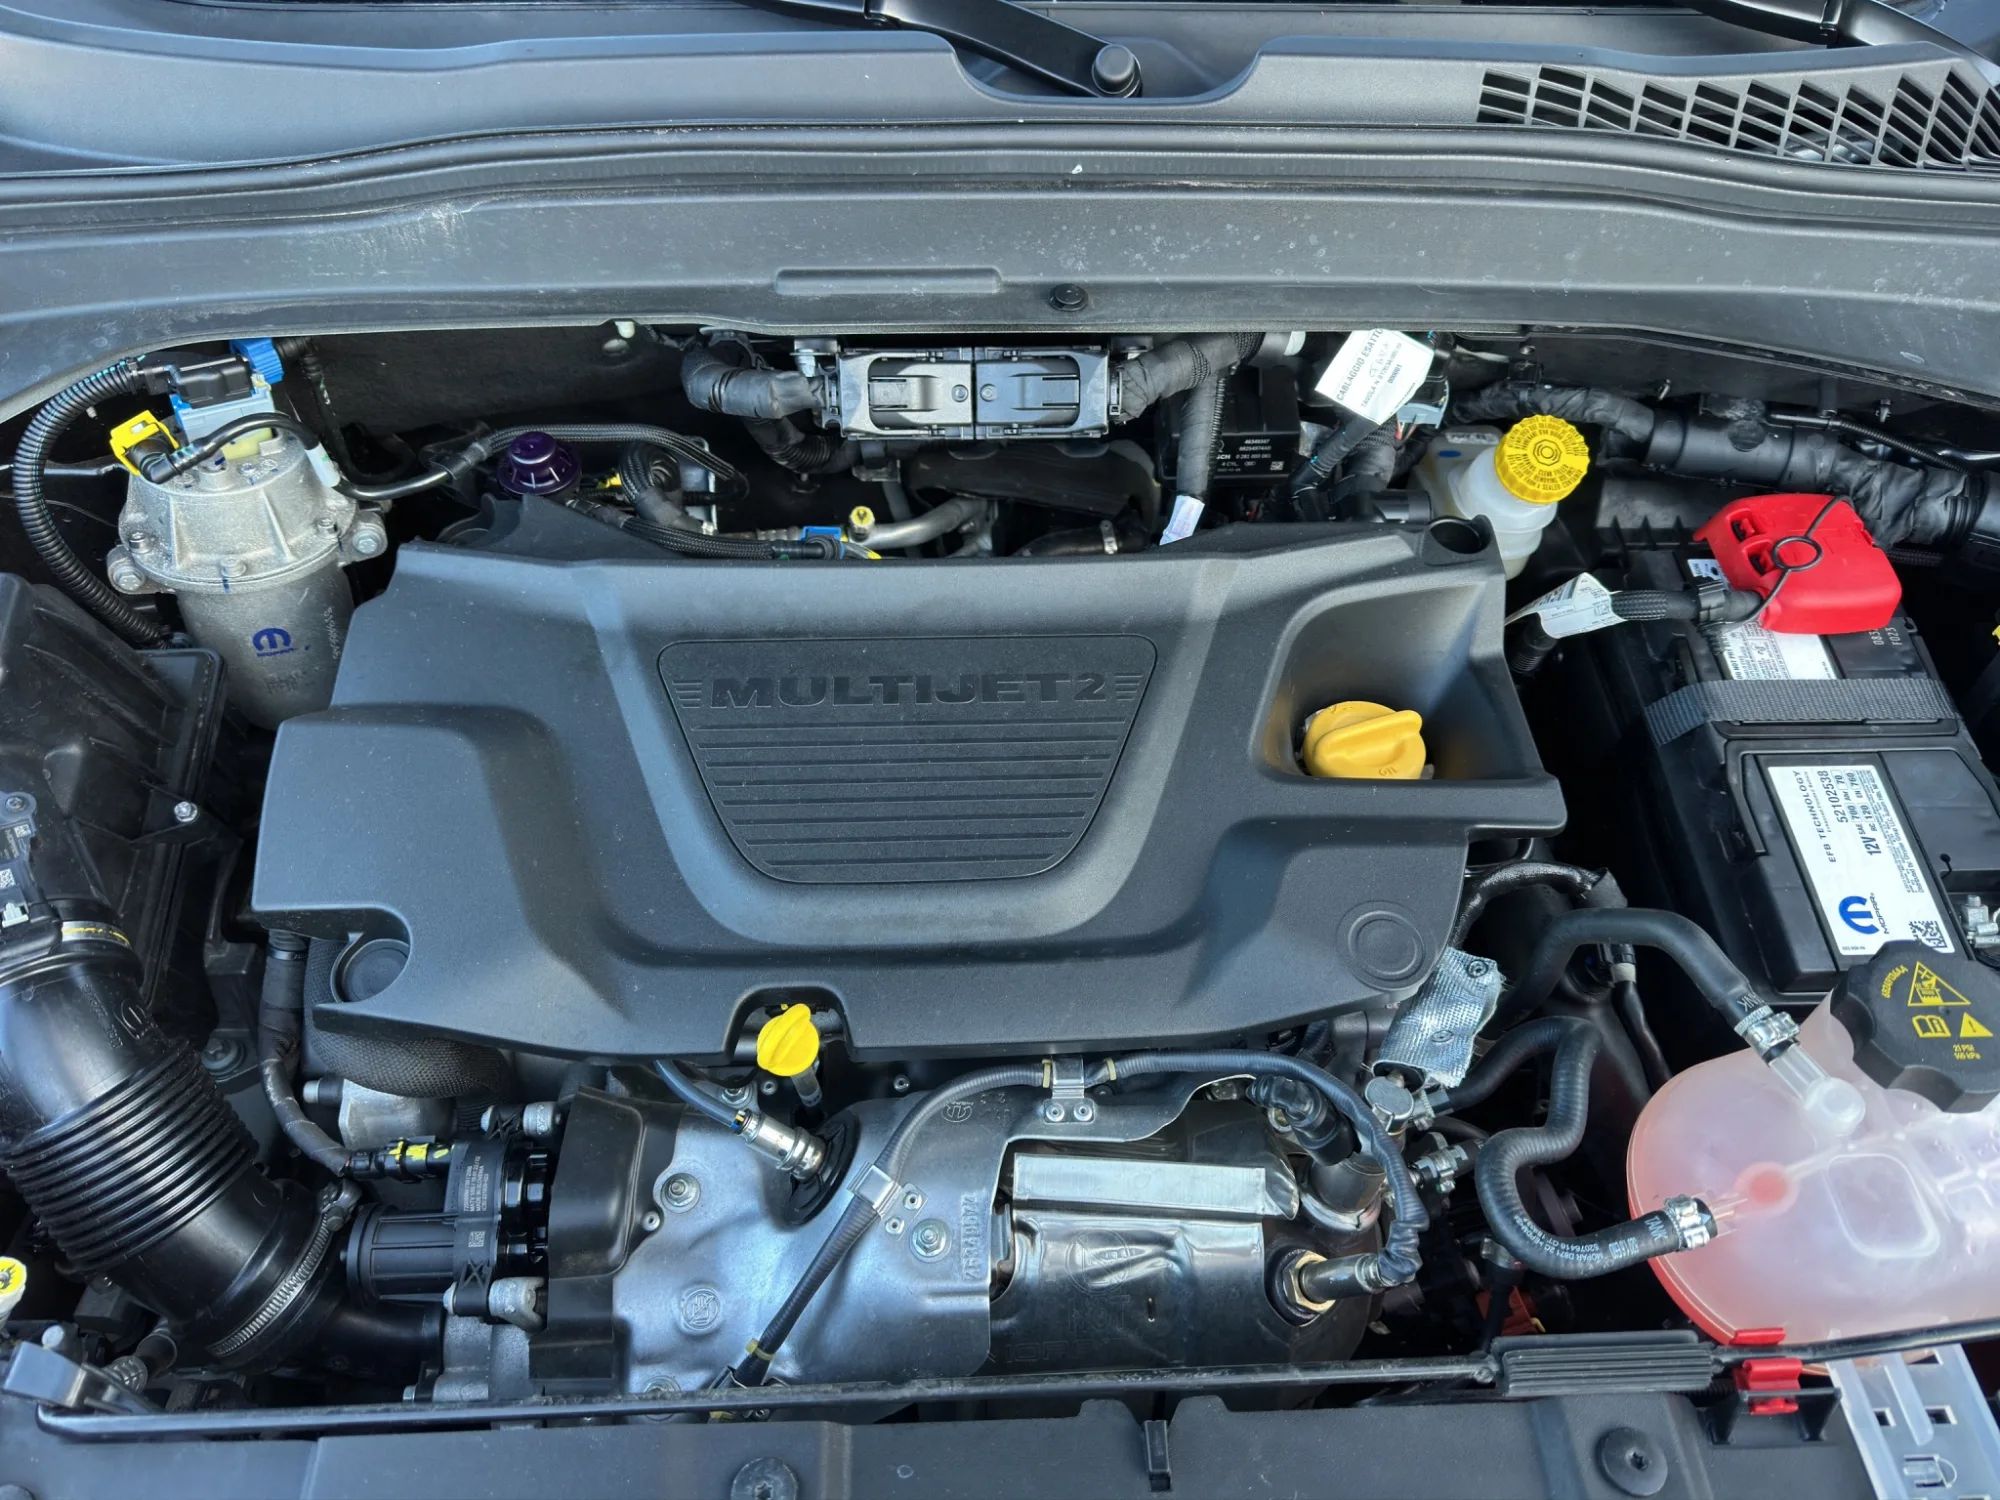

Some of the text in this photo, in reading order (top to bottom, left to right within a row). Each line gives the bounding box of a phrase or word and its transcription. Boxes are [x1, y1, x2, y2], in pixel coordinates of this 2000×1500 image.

[1336, 357, 1365, 401] CABLAGGIO
[1728, 660, 1741, 670] NOT
[1833, 774, 1845, 784] 70
[1845, 772, 1859, 786] 760
[1816, 770, 1849, 823] 52102538
[1791, 770, 1836, 862] EFB TECHNOLOGY
[1846, 805, 1860, 819] 700
[1860, 804, 1873, 819] 120
[1859, 836, 1883, 855] 12V
[1644, 1215, 1669, 1242] TANK
[1576, 1252, 1604, 1264] MOPAR
